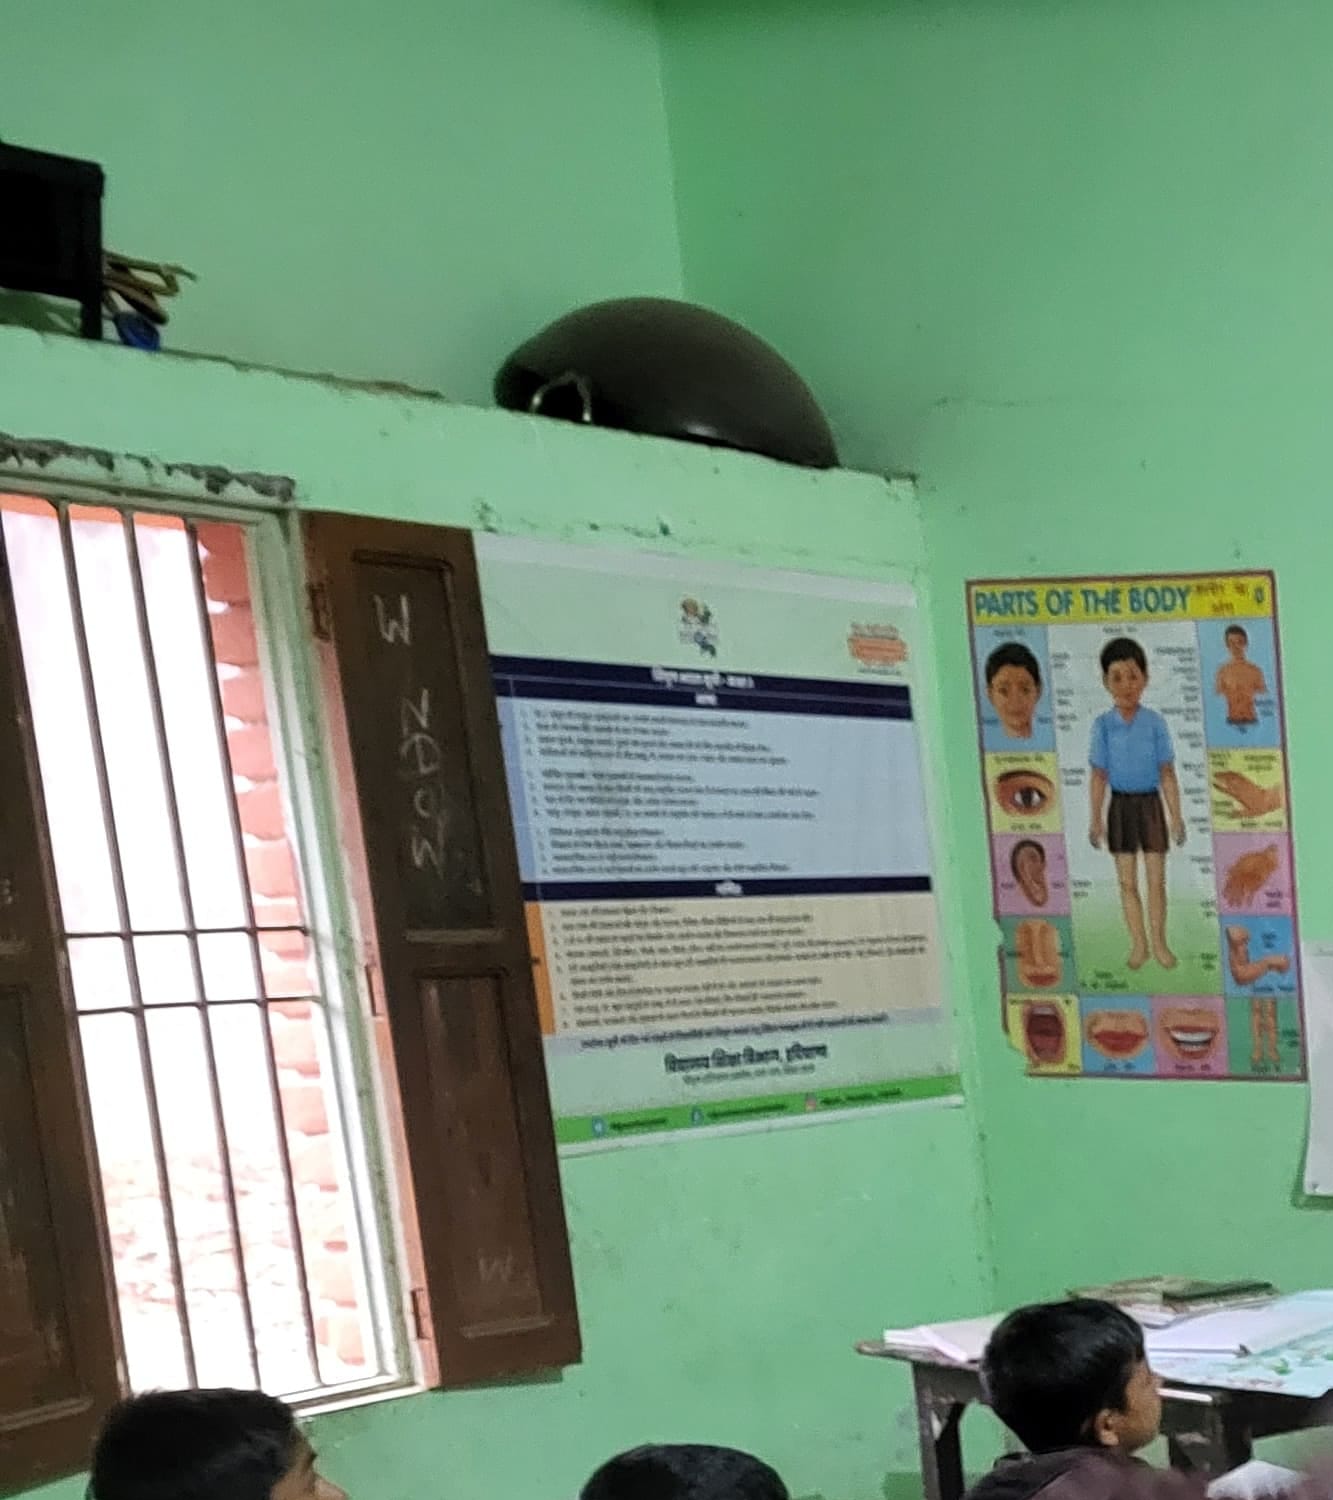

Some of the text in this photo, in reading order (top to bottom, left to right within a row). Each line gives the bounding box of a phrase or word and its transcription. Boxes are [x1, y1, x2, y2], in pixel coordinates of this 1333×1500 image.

[974, 585, 1191, 617] PARTS OF THE BODY
